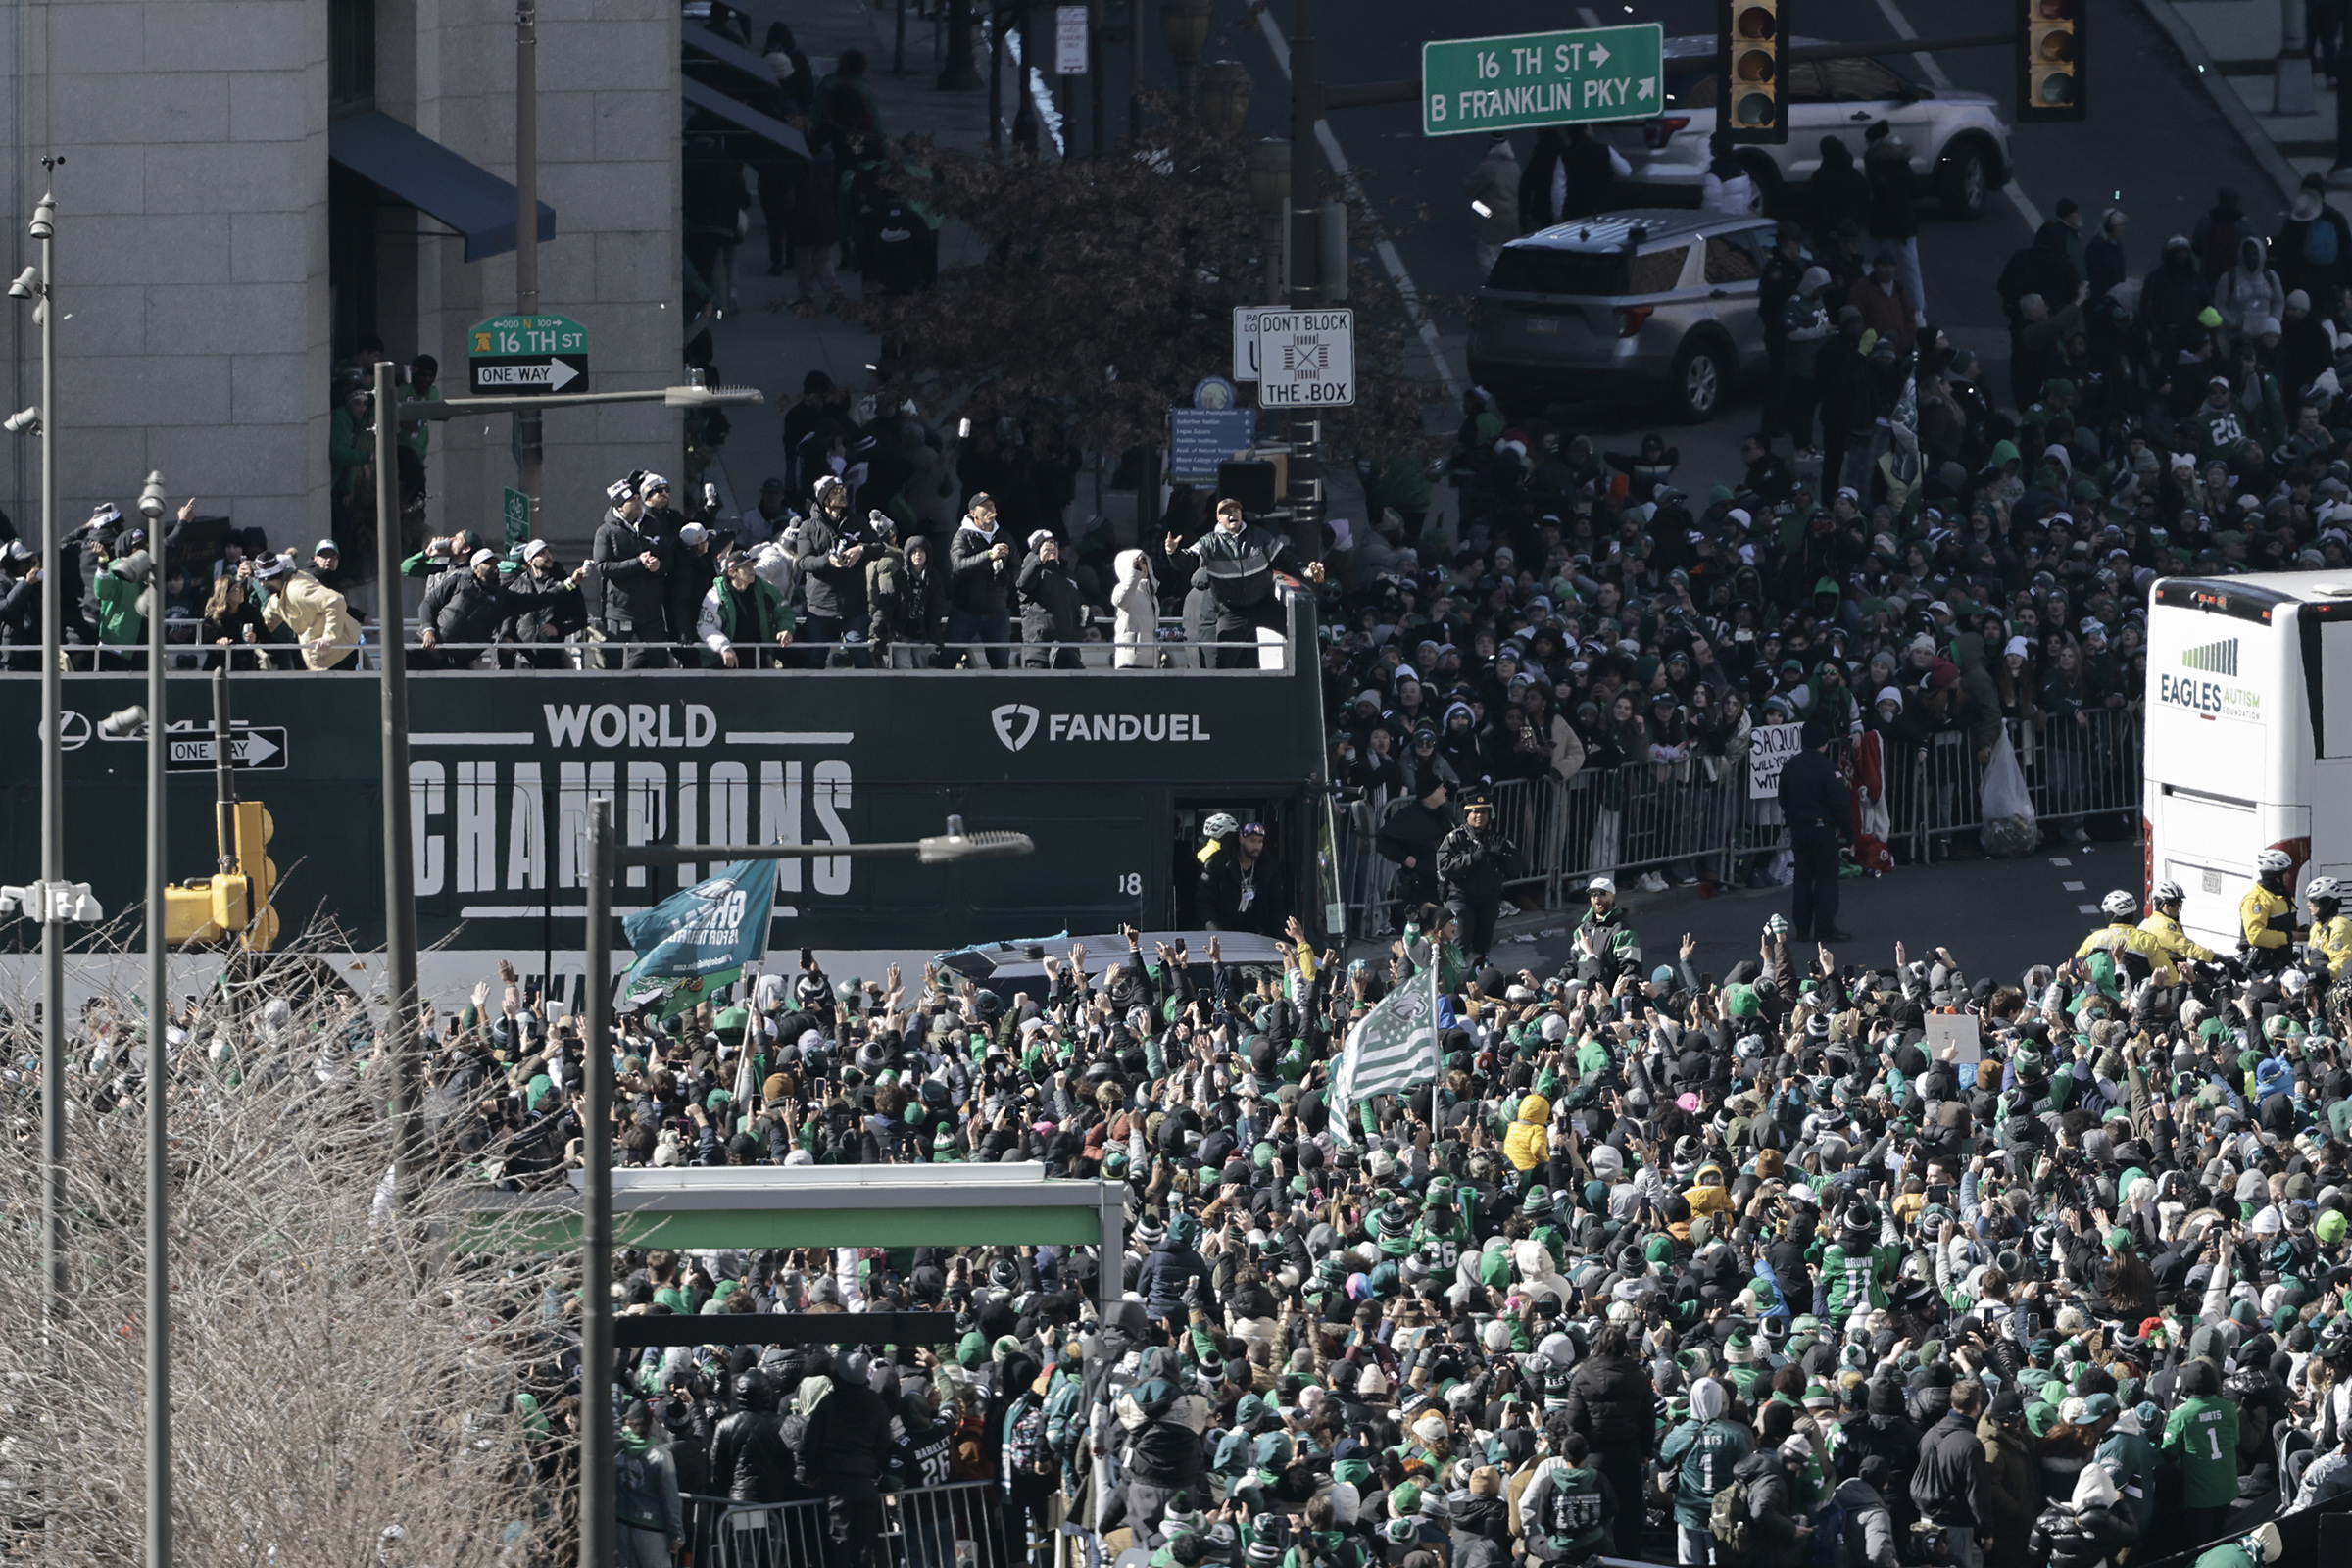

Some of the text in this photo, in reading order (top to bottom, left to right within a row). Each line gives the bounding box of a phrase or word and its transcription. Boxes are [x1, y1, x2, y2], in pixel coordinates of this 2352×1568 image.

[1477, 43, 1584, 79] 16 TH ST
[1431, 77, 1631, 122] B FRANKLIN PKY
[503, 318, 551, 329] 000 N 100
[1304, 314, 1348, 331] BLOCK
[499, 330, 583, 353] 16 TH ST
[482, 367, 551, 383] ONE WAY
[1266, 382, 1347, 403] THE BOX
[2161, 673, 2260, 712] EAGLES AUTISM
[2223, 706, 2260, 720] FOUNDATION
[543, 704, 717, 748] WORLD
[1050, 713, 1211, 742] FANDUEL
[175, 744, 209, 759] ONE
[1751, 757, 1774, 772] WILL
[1754, 773, 1780, 789] WIT
[409, 760, 852, 897] CHAMPIONS
[1118, 872, 1142, 896] 18
[2032, 1096, 2054, 1112] ARTER
[1844, 1256, 1874, 1269] BROWN
[1841, 1269, 1873, 1307] 11
[2198, 1409, 2223, 1423] HURTS
[914, 1435, 952, 1462] BARKLEY
[2206, 1427, 2223, 1460] 1
[920, 1450, 952, 1488] 26
[1697, 1453, 1716, 1492] 1
